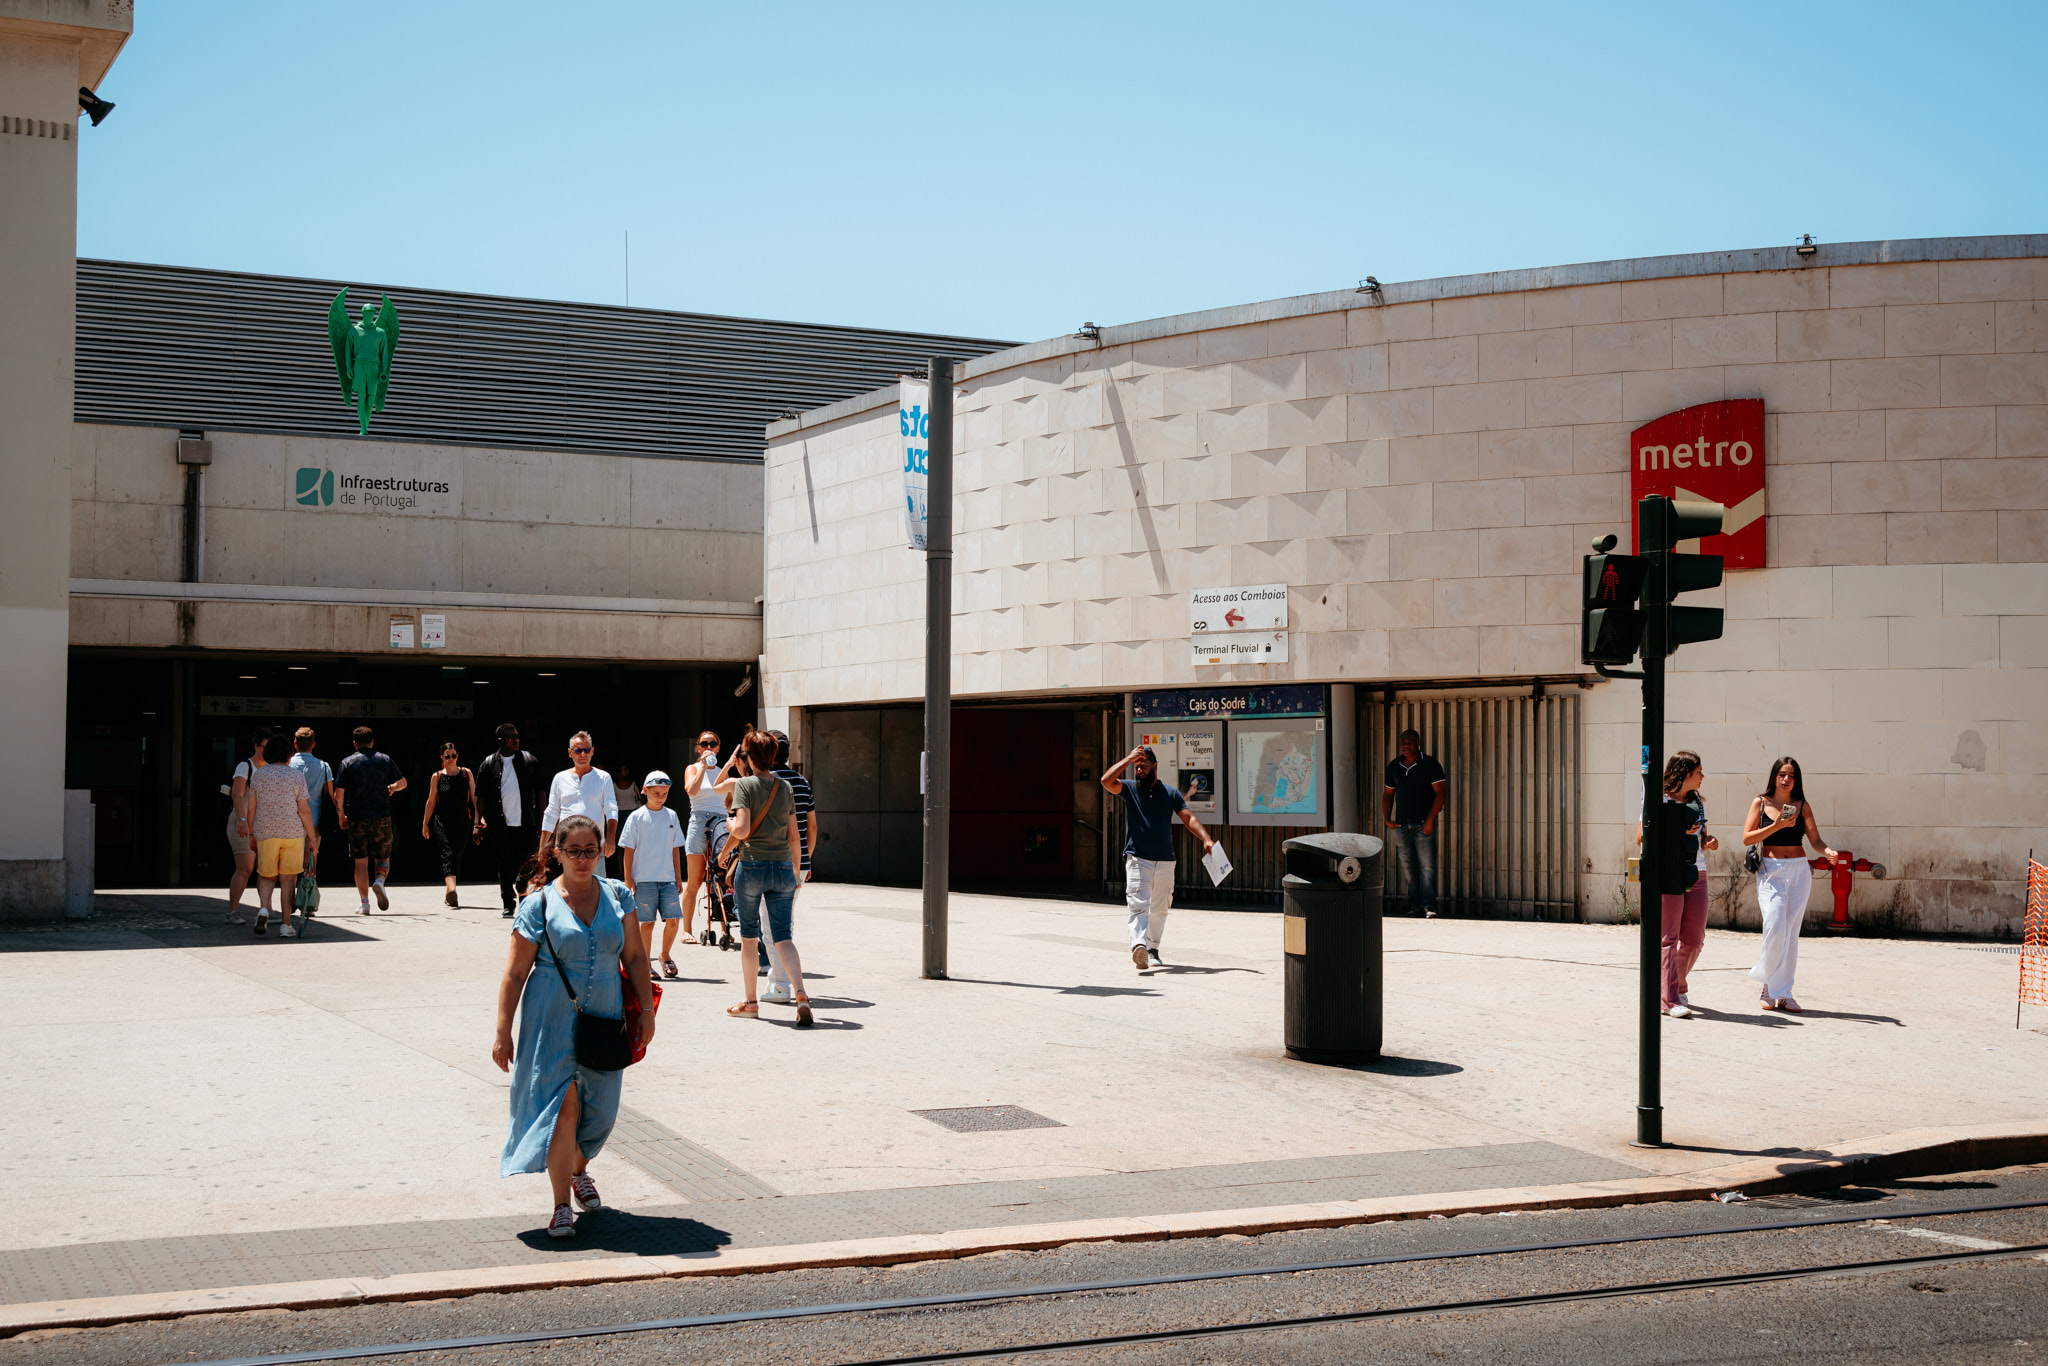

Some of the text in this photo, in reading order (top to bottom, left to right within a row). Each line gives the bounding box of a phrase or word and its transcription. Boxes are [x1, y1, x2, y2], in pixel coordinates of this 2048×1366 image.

[1639, 435, 1753, 471] metro
[340, 475, 449, 493] Infraestruturas
[340, 491, 417, 510] de Portugal
[1192, 589, 1286, 604] Acesso aos Comboios
[1193, 644, 1259, 655] Terminal Fluvial
[1189, 697, 1246, 711] Cais do Sodré
